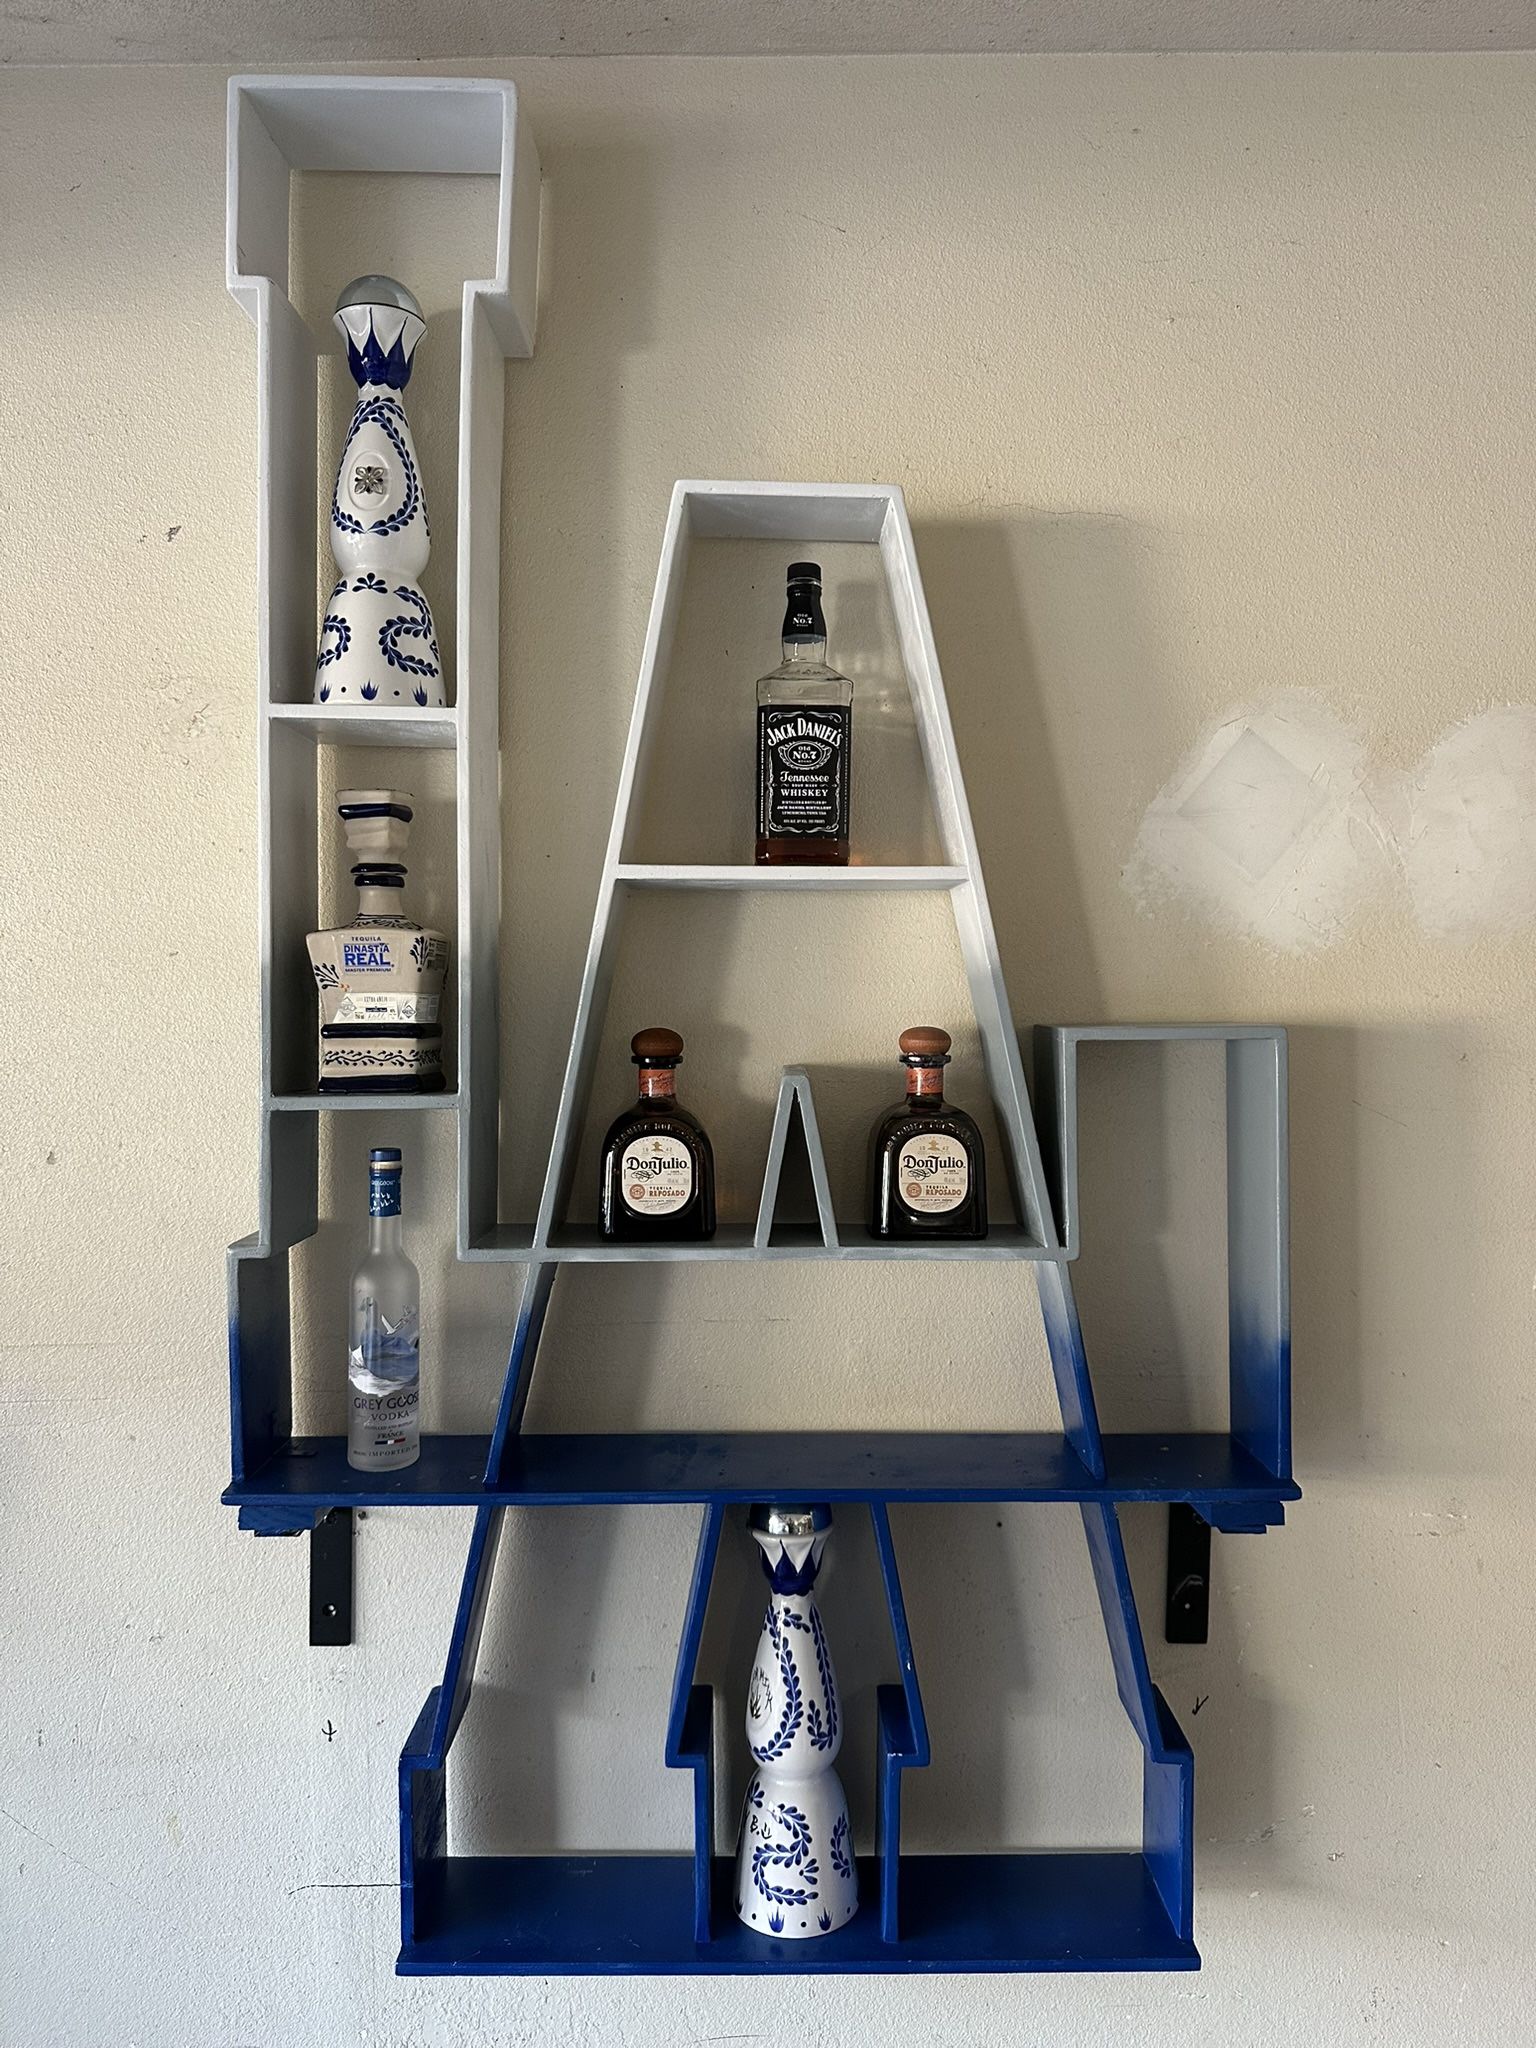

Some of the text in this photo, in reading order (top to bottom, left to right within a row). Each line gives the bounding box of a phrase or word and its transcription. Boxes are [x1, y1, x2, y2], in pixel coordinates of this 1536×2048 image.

[767, 718, 843, 747] JACK DANIEL'S
[780, 771, 830, 782] Tennessee
[780, 788, 828, 796] WHISKEY
[345, 953, 391, 966] REAL
[353, 1397, 383, 1410] GREY
[371, 1410, 410, 1421] VODKA
[377, 1431, 404, 1439] FRANCE
[368, 1446, 411, 1457] IMPORTED
